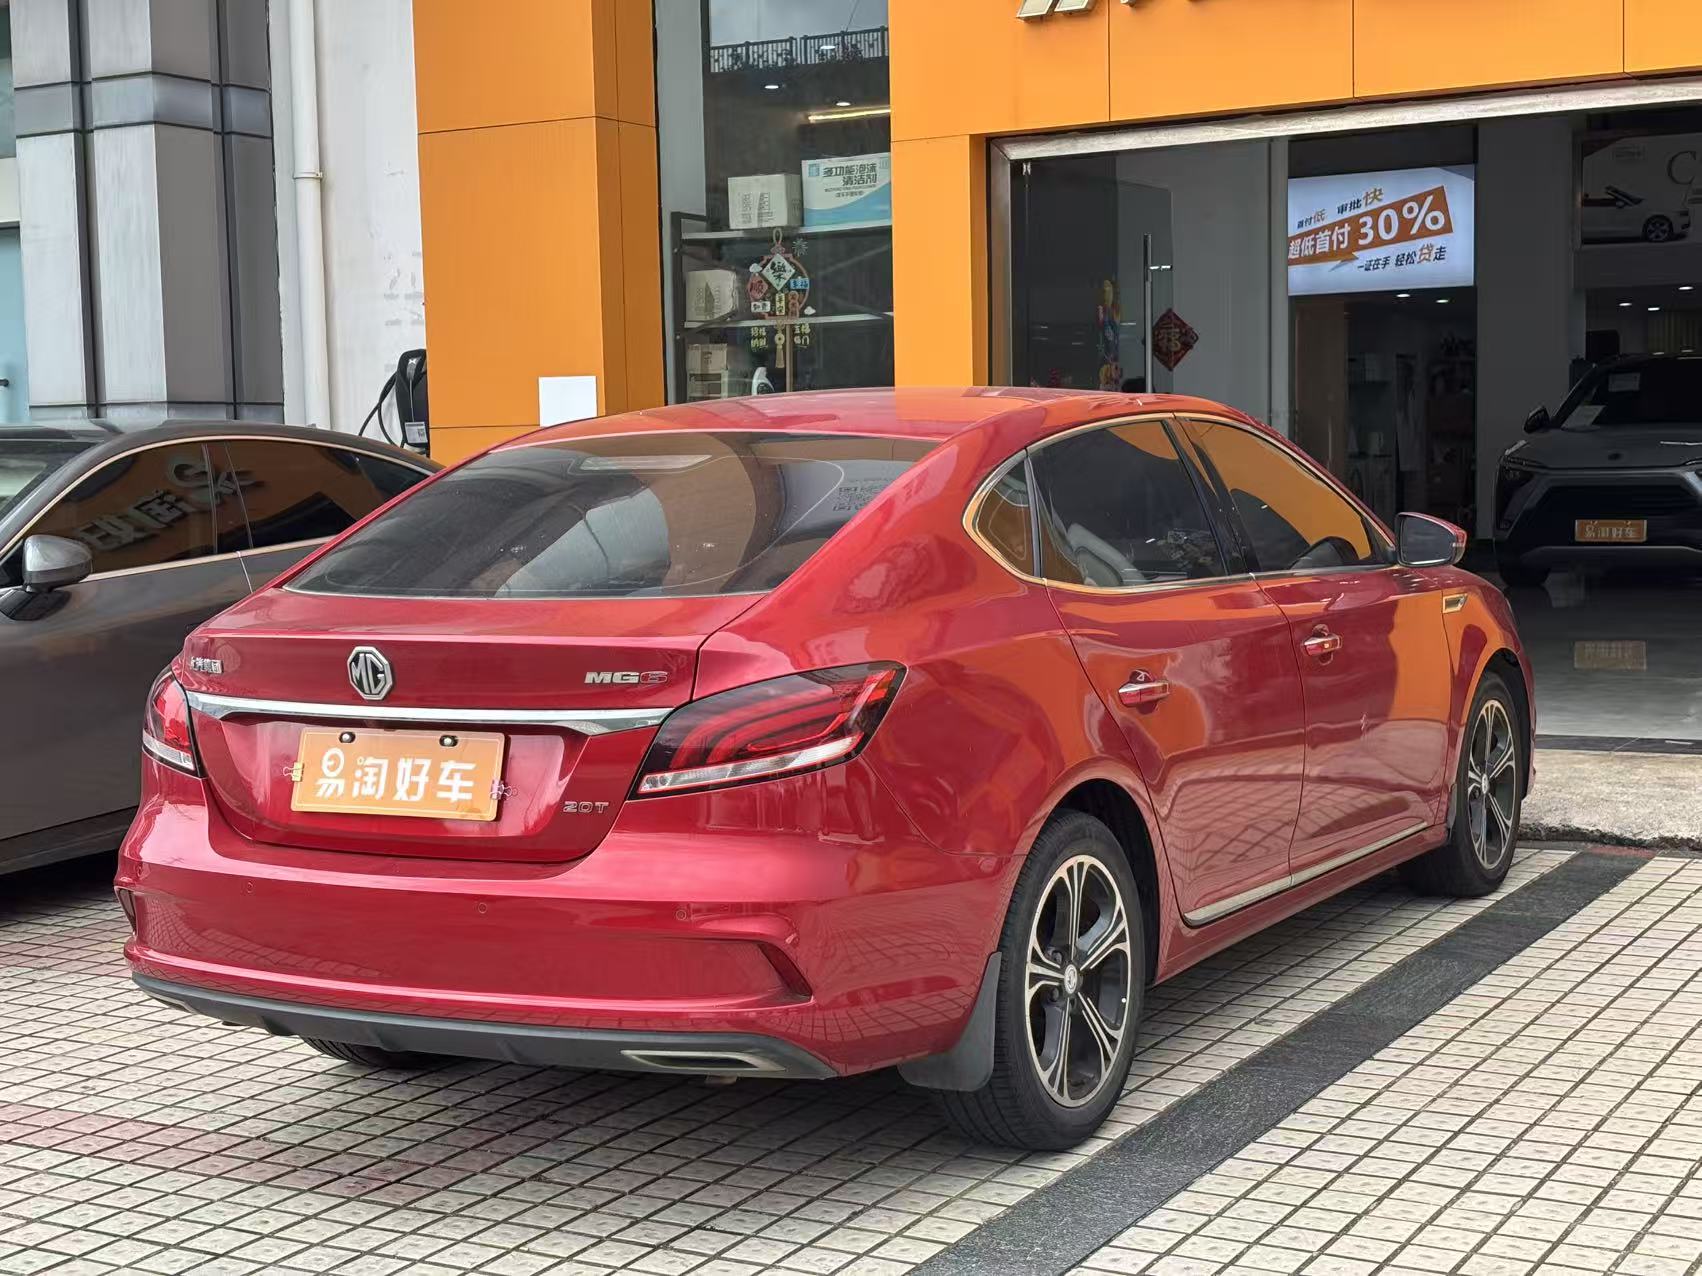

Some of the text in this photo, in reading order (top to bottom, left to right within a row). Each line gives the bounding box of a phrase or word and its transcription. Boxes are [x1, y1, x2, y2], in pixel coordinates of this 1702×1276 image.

[822, 163, 878, 178] 多功能泡沫
[842, 174, 878, 187] 清洁剂
[1296, 187, 1384, 229] 首付低 审批快
[1287, 194, 1446, 259] 超低首付 30%
[1357, 243, 1447, 272] 一证在手 轻松贷走
[350, 651, 387, 696] MG
[584, 671, 668, 684] MG6
[315, 747, 477, 803] 易淘好车
[563, 801, 609, 813] 20T
